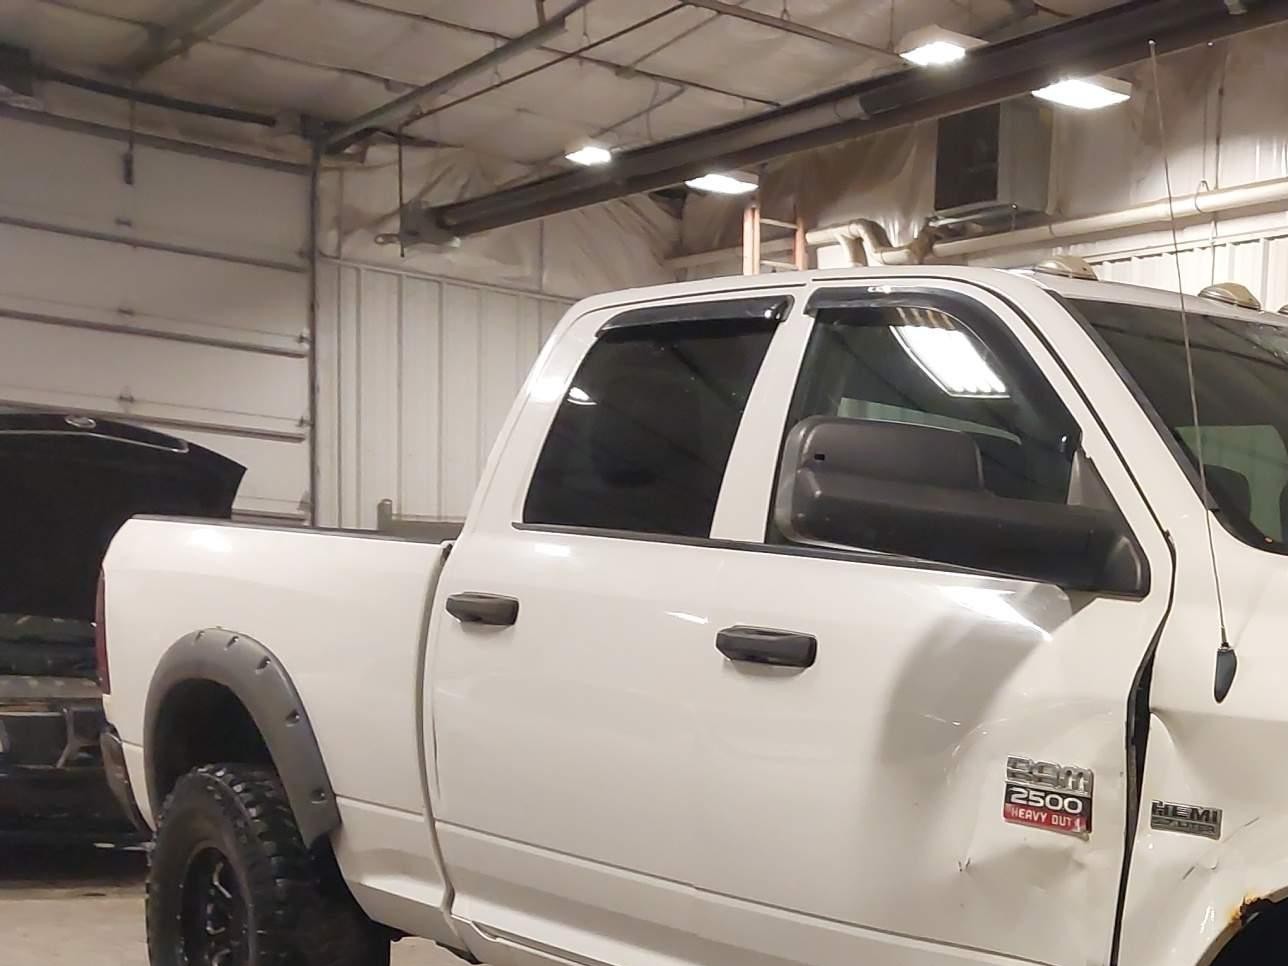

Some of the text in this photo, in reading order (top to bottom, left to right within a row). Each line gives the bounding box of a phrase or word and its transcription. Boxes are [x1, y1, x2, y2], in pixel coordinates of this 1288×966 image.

[1008, 787, 1083, 814] 2500
[1152, 800, 1219, 824] HEMI
[1011, 807, 1048, 822] HEAVY
